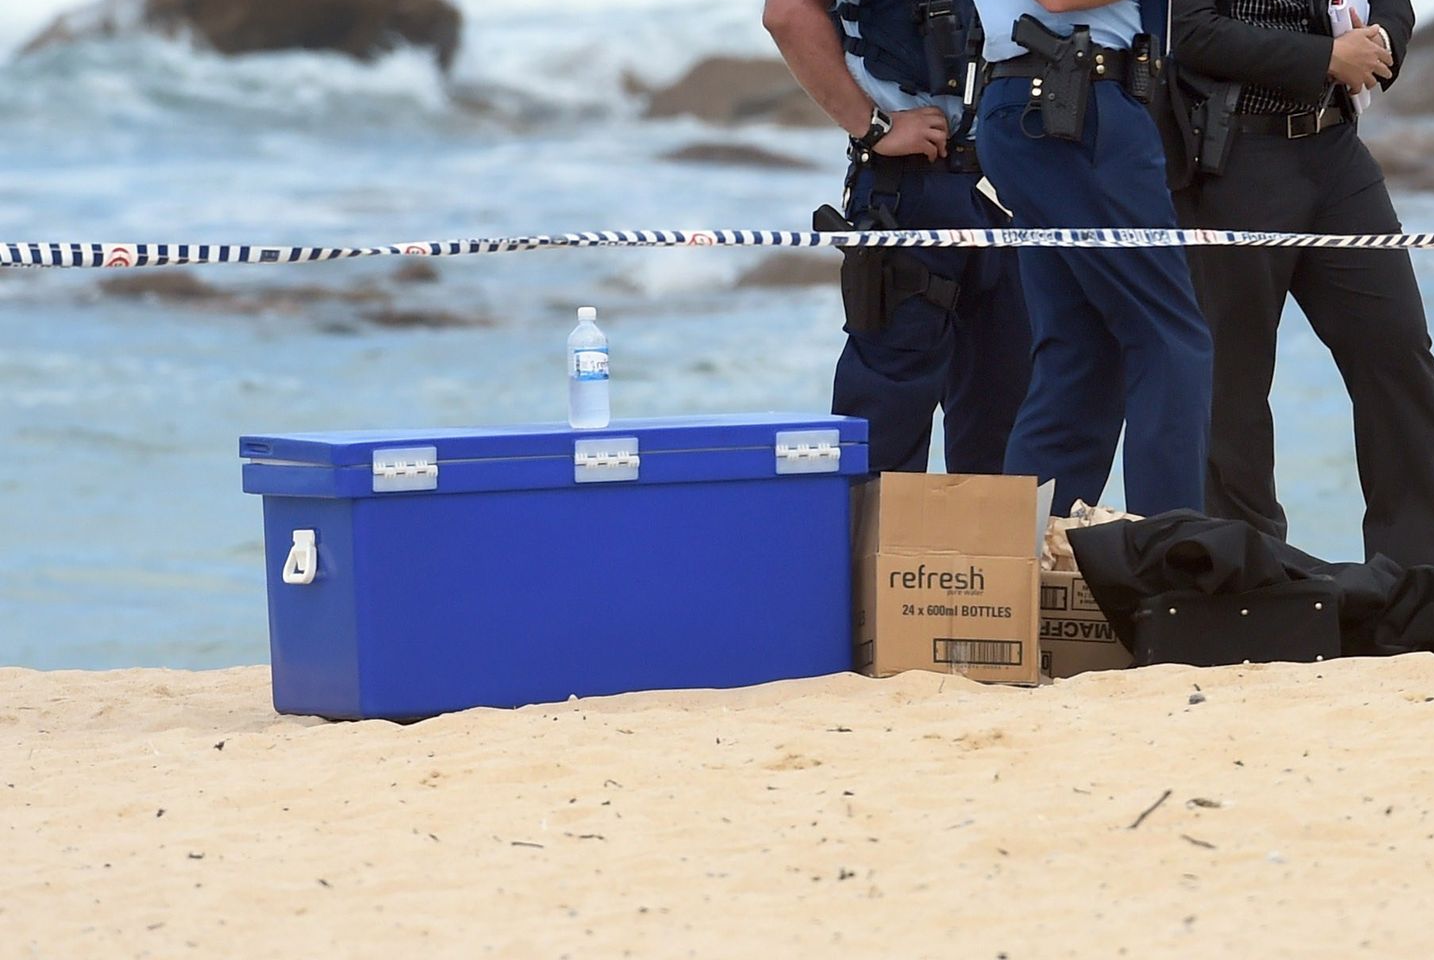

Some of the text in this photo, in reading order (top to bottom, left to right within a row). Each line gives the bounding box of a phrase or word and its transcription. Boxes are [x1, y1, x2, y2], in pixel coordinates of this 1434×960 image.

[889, 564, 985, 590] refresh
[902, 605, 1012, 618] 24 x 600ml BOTTLES
